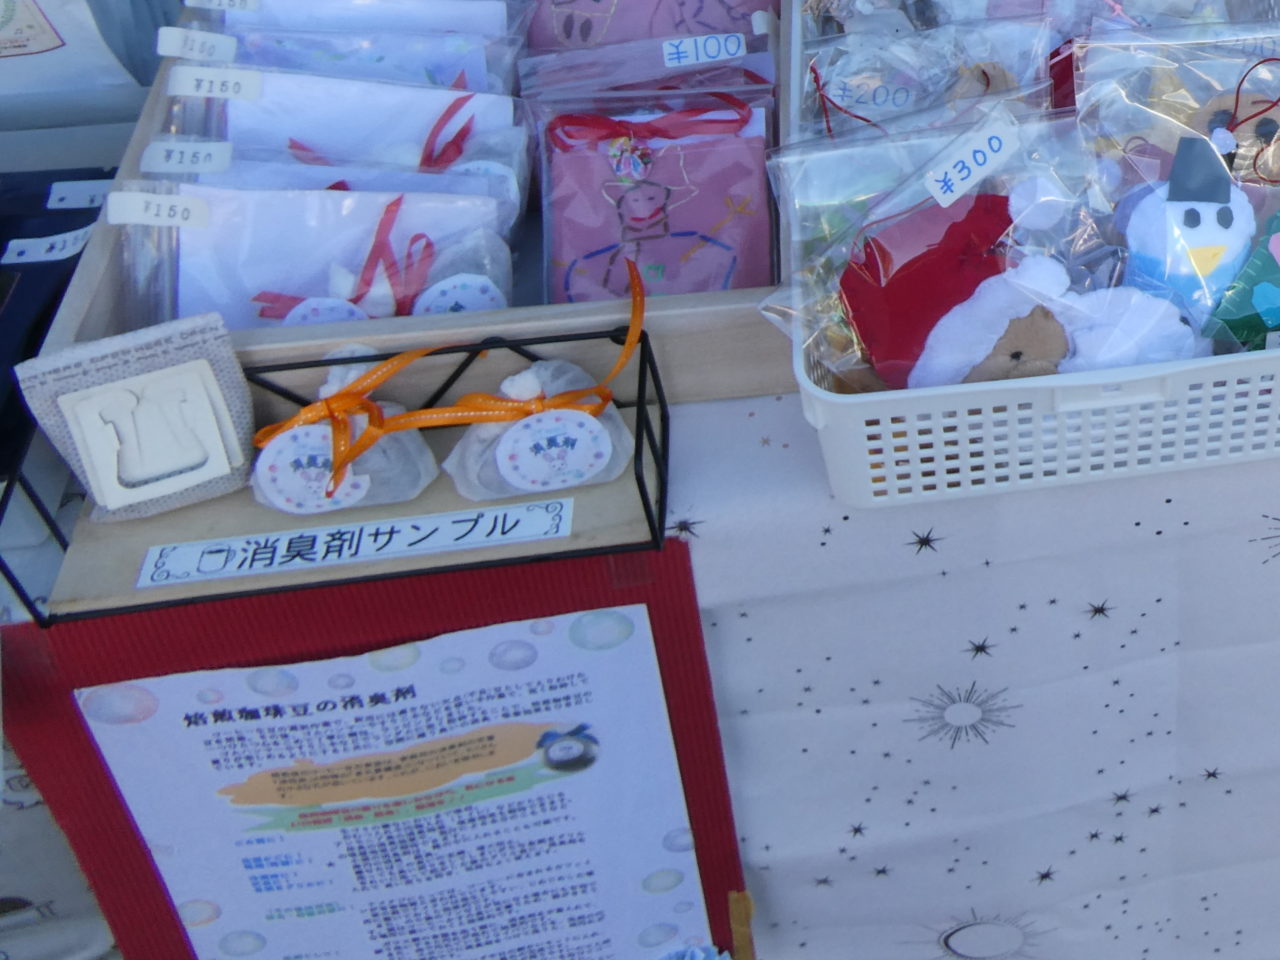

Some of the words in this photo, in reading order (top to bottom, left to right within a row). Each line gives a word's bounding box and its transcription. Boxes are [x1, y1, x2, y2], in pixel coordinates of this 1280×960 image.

[666, 33, 742, 65] ¥100
[193, 78, 243, 95] ¥150
[832, 81, 911, 108] ¥200
[163, 148, 213, 164] ¥150
[934, 135, 1003, 195] ¥300
[143, 200, 191, 222] ¥150
[236, 511, 521, 571] 消臭剤サンプル
